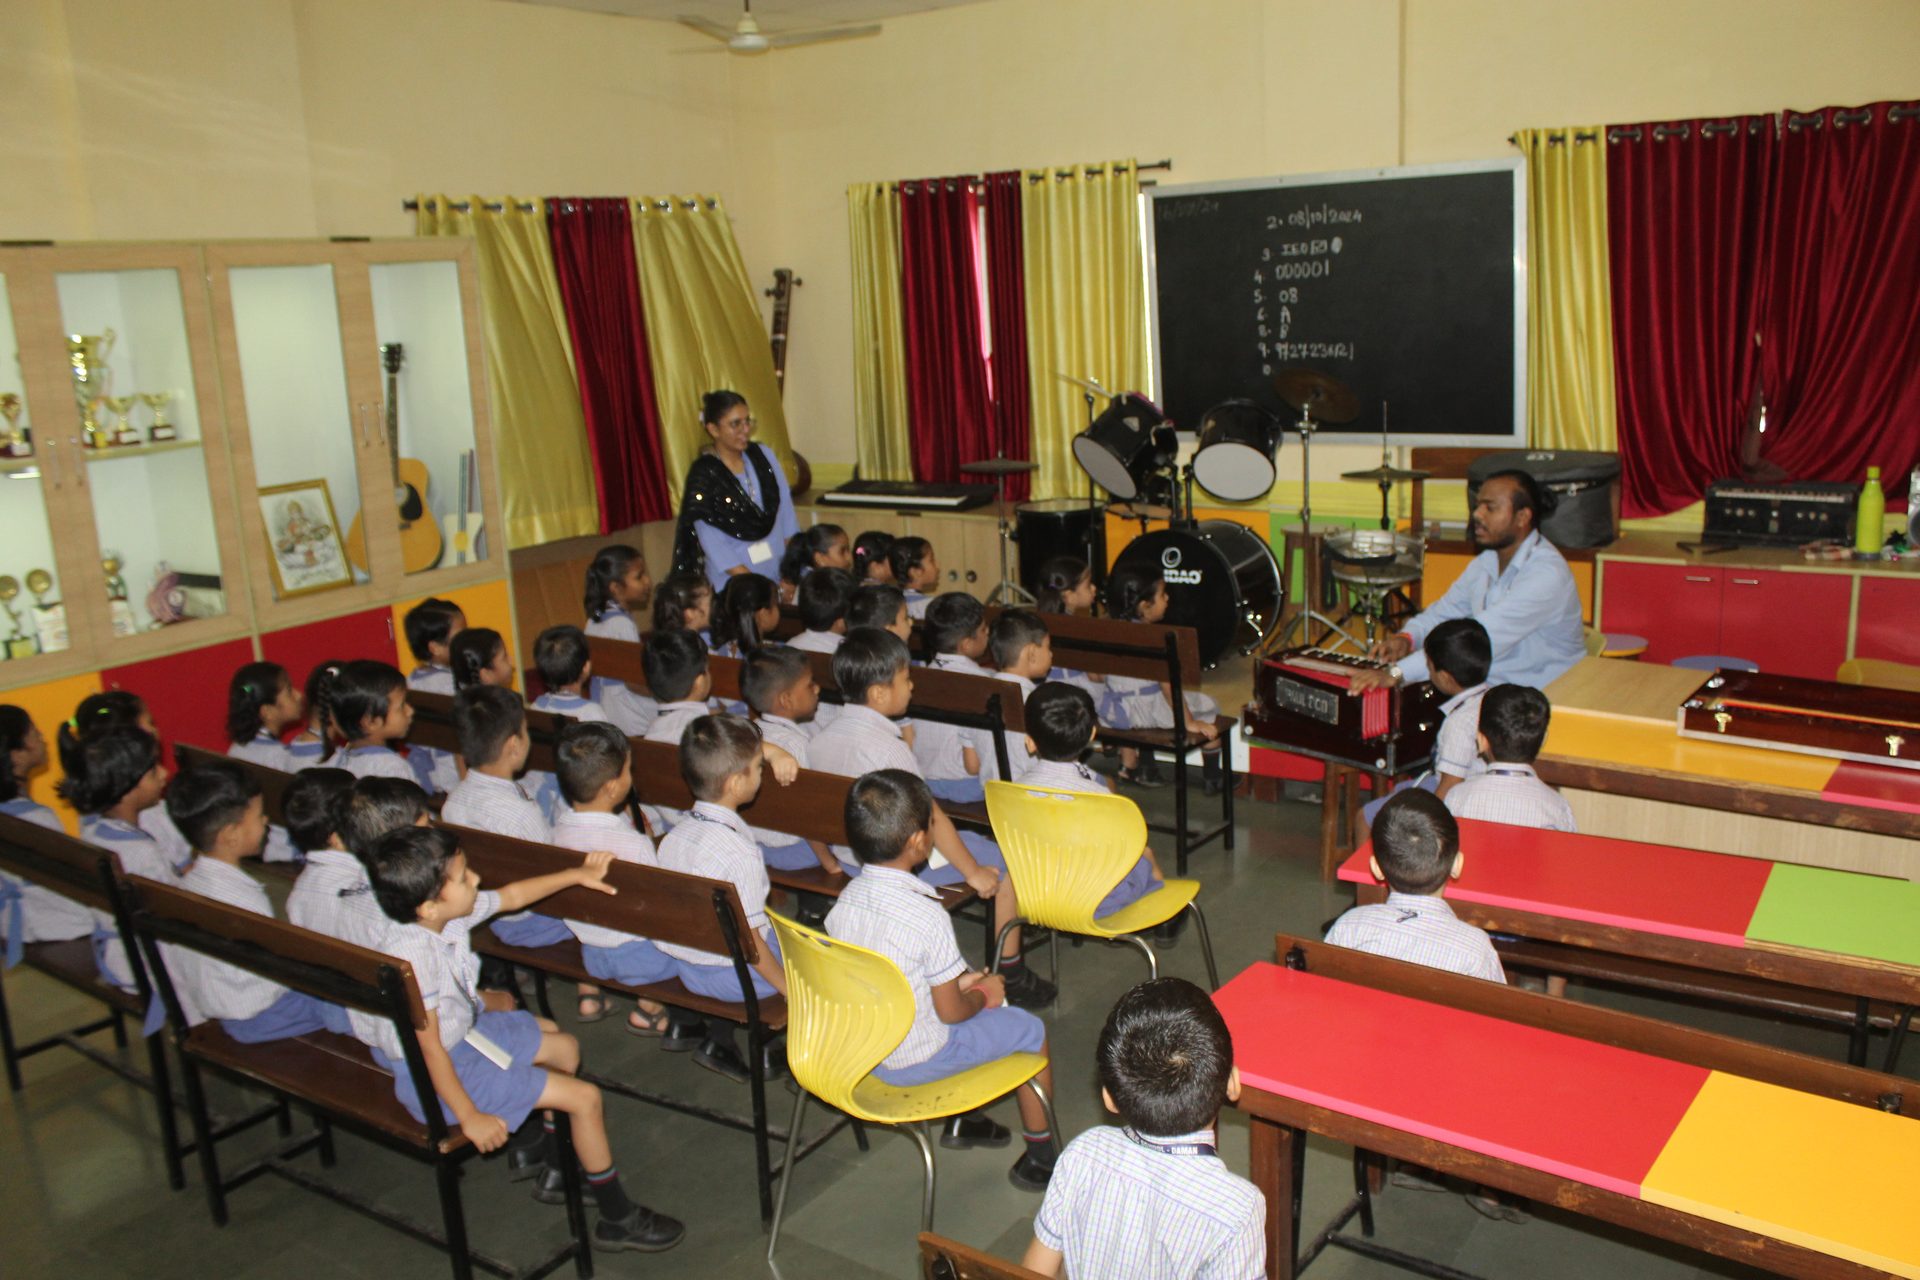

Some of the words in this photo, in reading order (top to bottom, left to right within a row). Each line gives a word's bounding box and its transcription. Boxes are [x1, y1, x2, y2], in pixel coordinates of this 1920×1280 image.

[1278, 286, 1299, 304] 08
[1279, 305, 1292, 324] A
[1171, 1146, 1198, 1155] DAMAN
